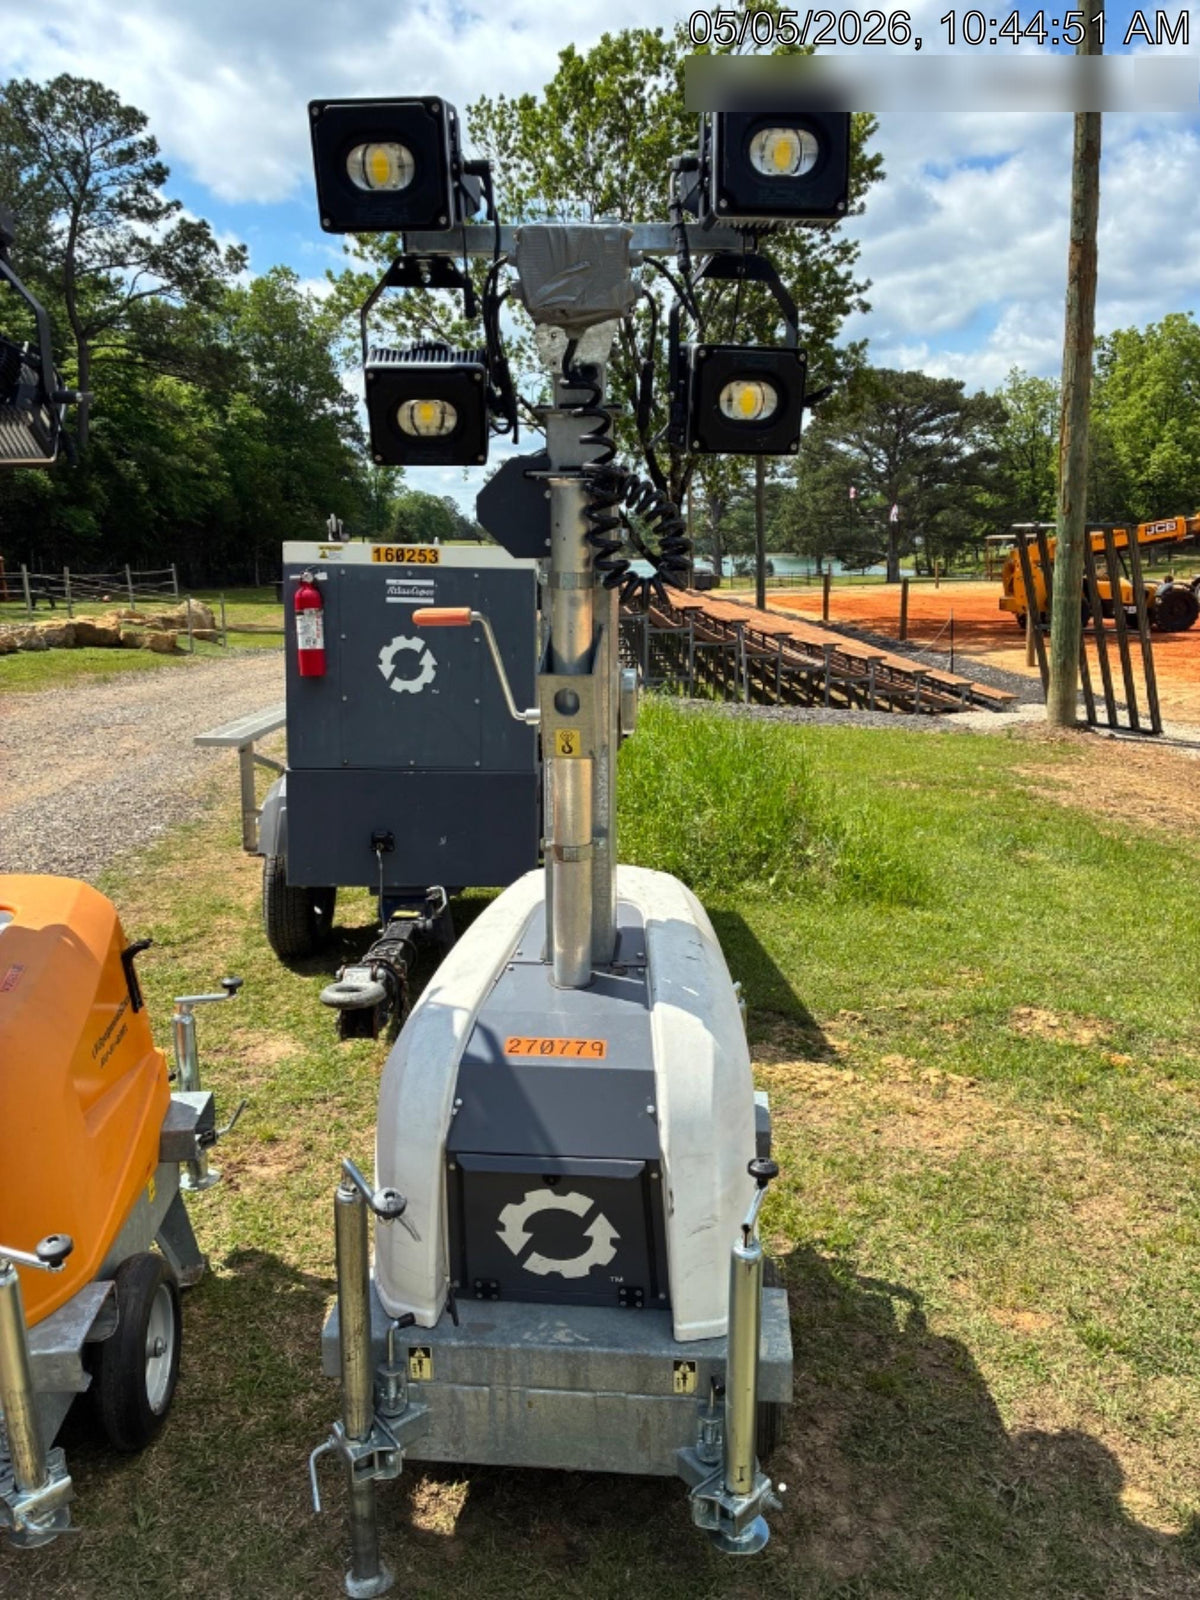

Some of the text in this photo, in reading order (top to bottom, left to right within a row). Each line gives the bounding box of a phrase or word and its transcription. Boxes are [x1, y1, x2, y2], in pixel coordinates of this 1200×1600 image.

[1146, 522, 1176, 535] JCB
[373, 547, 438, 563] 160253
[507, 1038, 604, 1056] 270779
